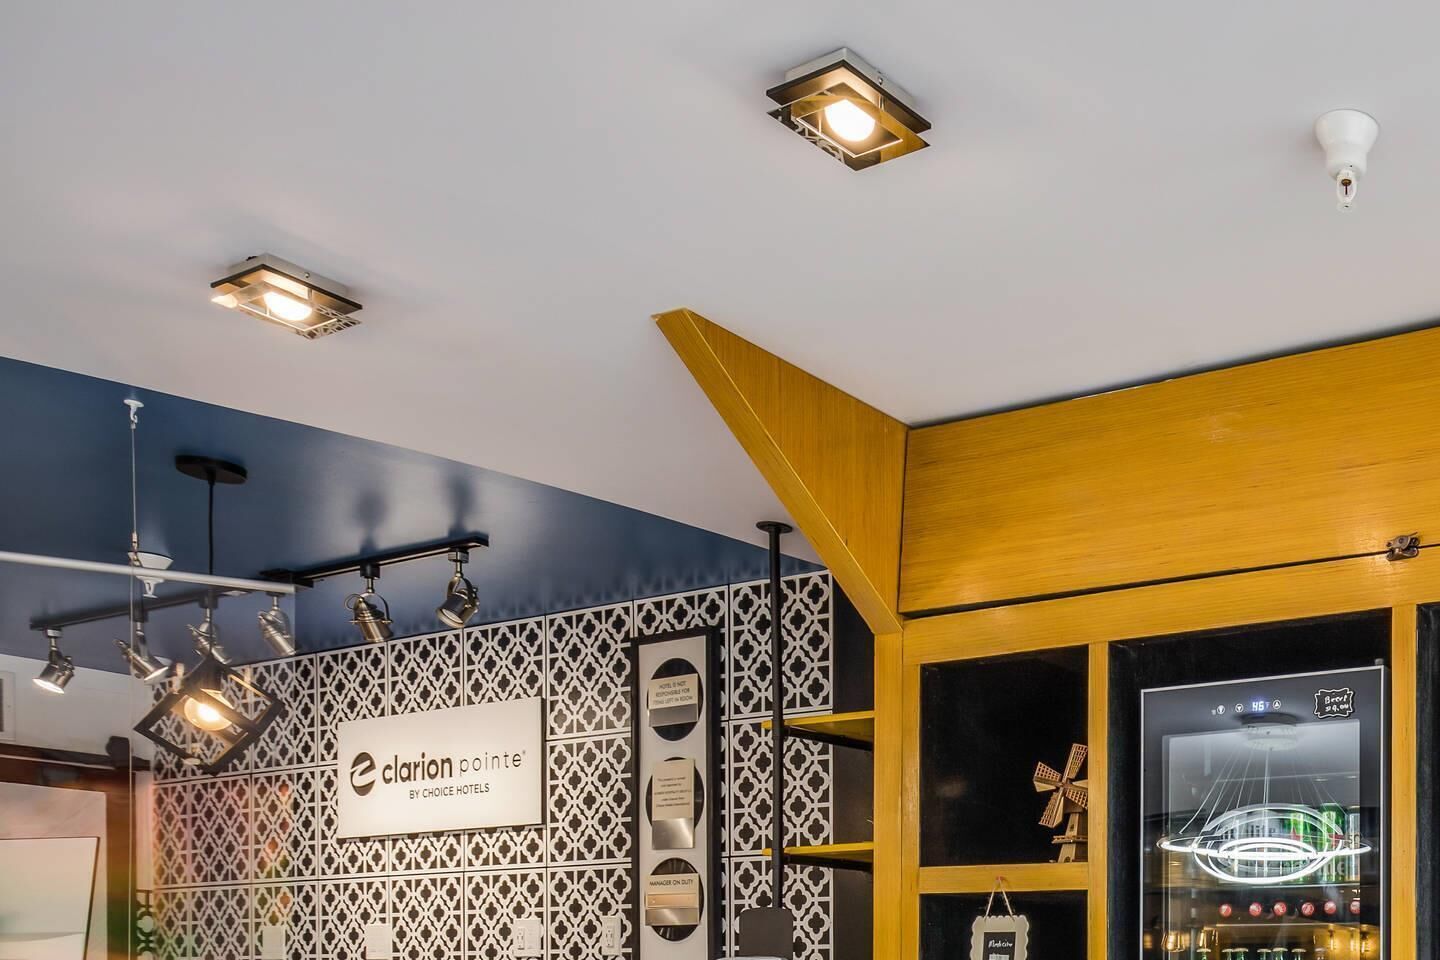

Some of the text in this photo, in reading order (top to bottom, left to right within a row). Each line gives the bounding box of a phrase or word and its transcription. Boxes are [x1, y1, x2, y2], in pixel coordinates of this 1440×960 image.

[382, 751, 522, 784] clarion pointe
[409, 783, 490, 800] BY CHOICE HOTELS
